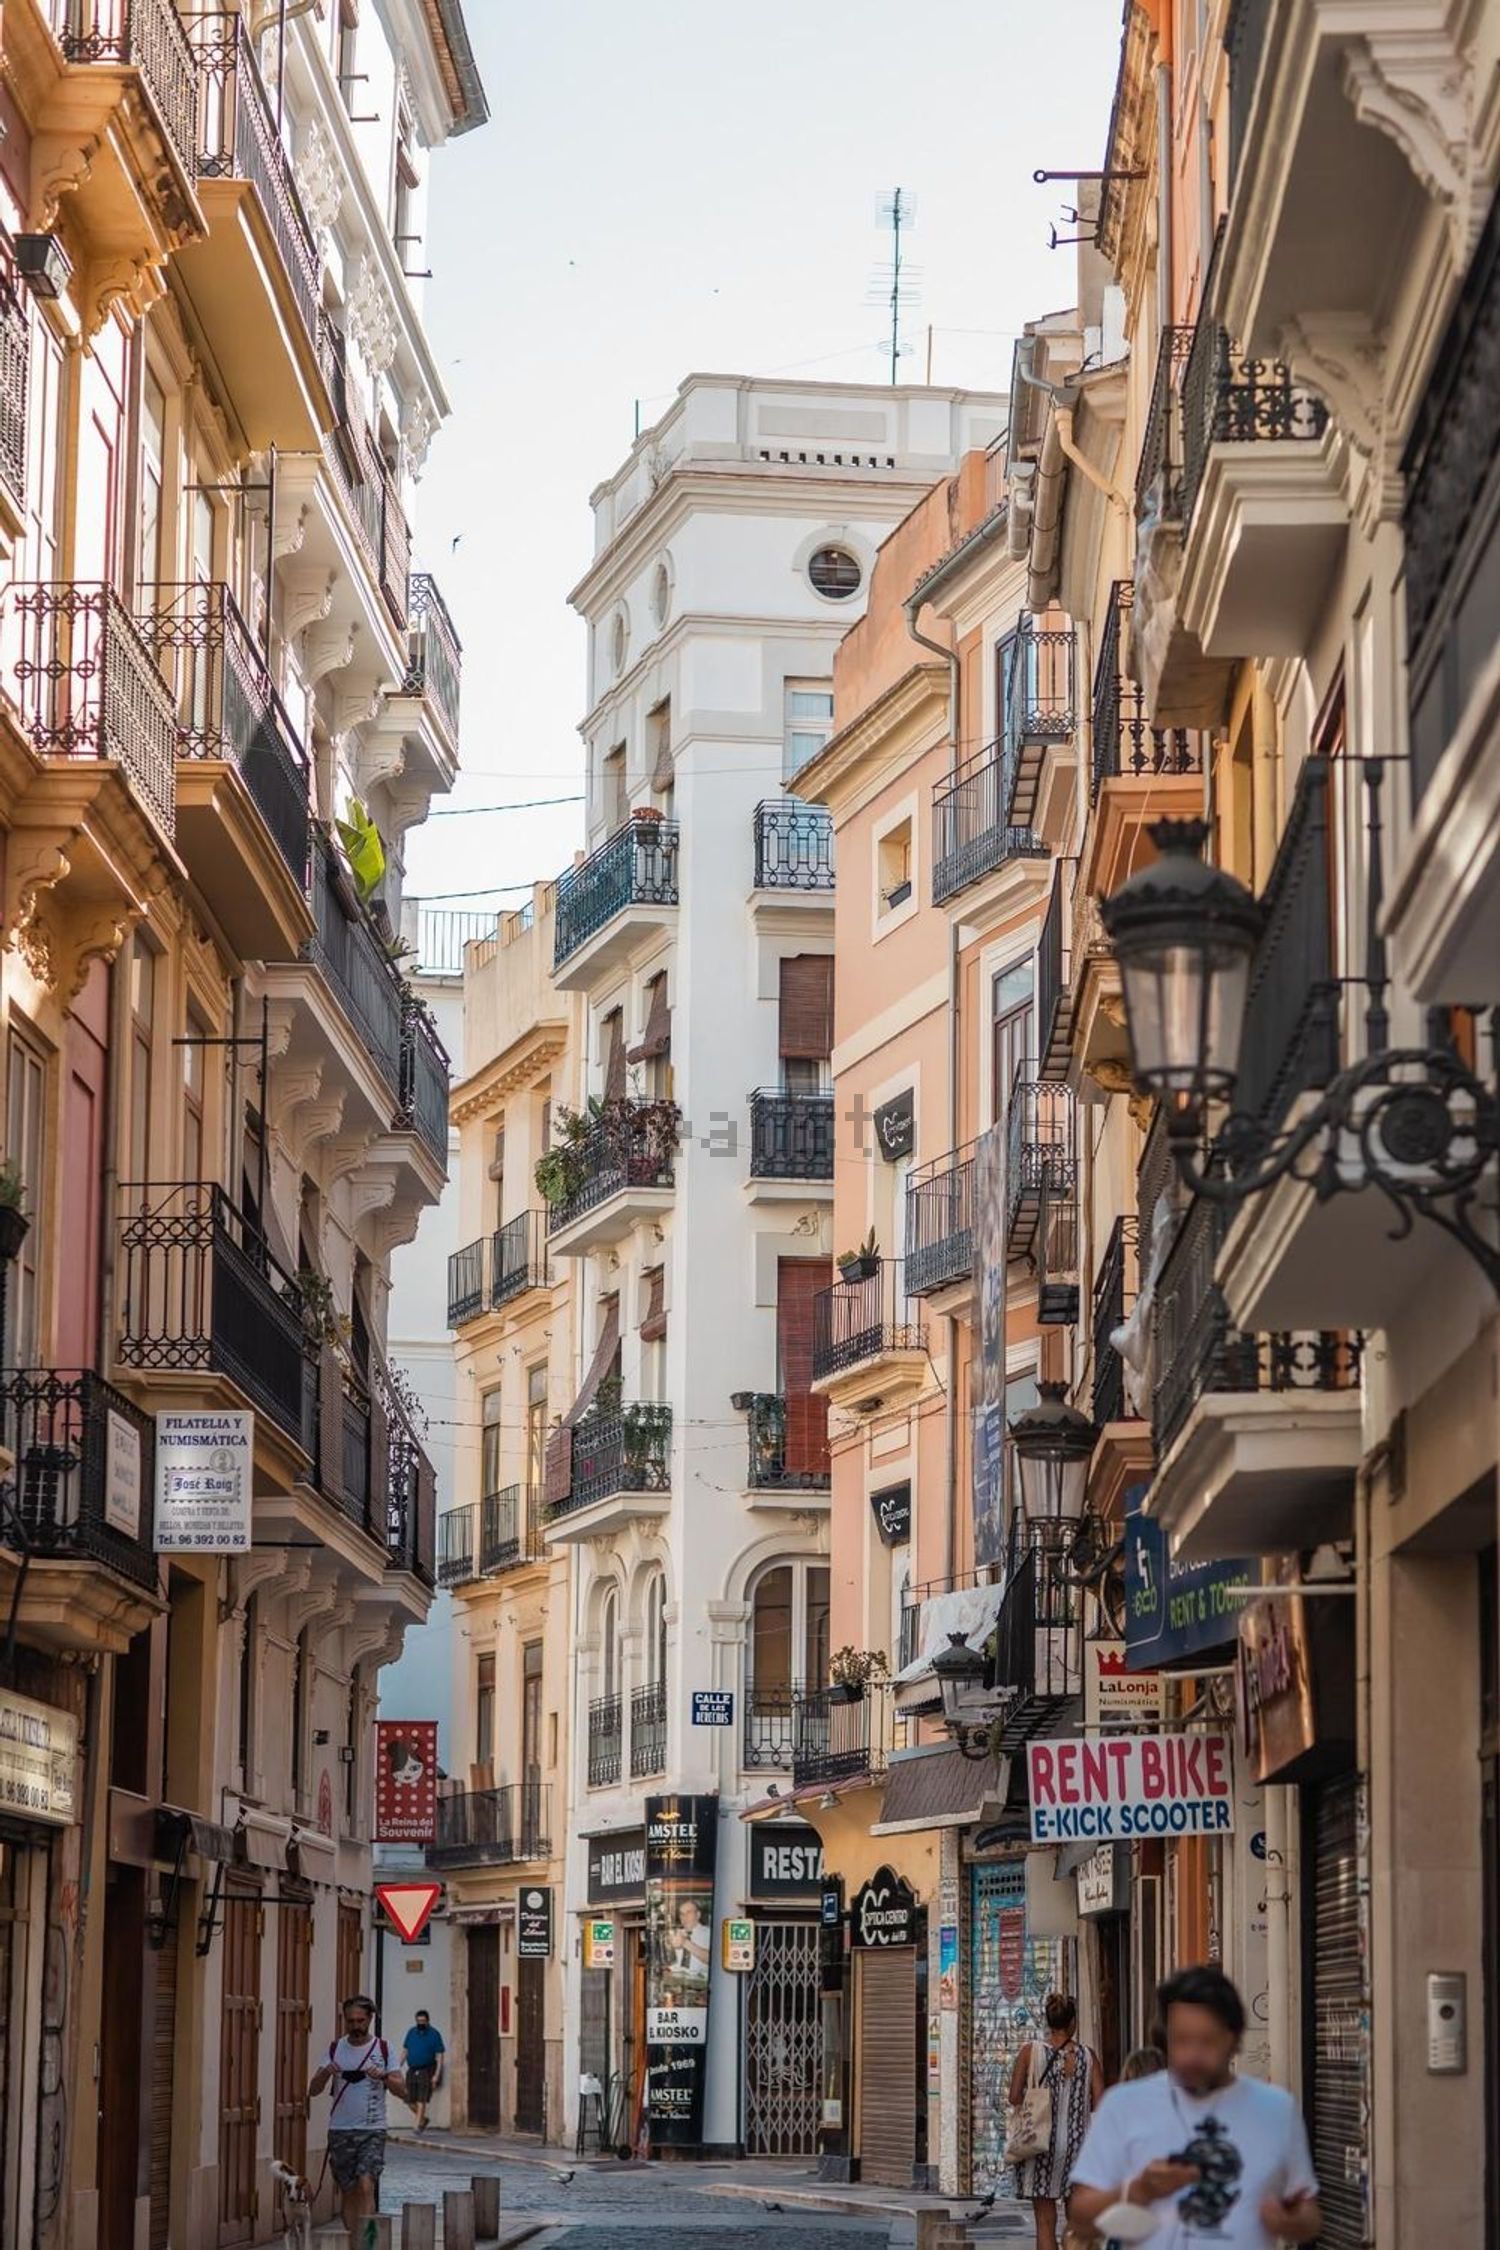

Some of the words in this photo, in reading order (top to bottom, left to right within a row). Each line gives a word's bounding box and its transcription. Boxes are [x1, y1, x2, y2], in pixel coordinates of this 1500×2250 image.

[166, 1418, 230, 1429] FILATELIA
[235, 1418, 242, 1429] Y
[160, 1431, 248, 1446] NUMISMÁTICA
[173, 1476, 201, 1492] José
[205, 1477, 233, 1492] Roig
[157, 1534, 175, 1545] Tel.
[178, 1534, 192, 1545] 96
[195, 1534, 214, 1545] 392
[216, 1534, 230, 1545] 00
[232, 1534, 246, 1545] 82
[1168, 1591, 1195, 1631] RENT
[1198, 1587, 1206, 1622] &
[1209, 1573, 1248, 1618] TOURS
[695, 1693, 731, 1705] CALLE
[695, 1711, 729, 1724] DERECHOS
[1032, 1742, 1132, 1806] RENT
[1141, 1737, 1229, 1799] BIKE
[379, 1818, 391, 1827] La
[392, 1817, 417, 1827] Reina
[419, 1817, 433, 1827] del
[1035, 1805, 1113, 1838] E-KICK
[1119, 1800, 1230, 1834] SCOOTER
[379, 1826, 433, 1838] Souvenir
[648, 1823, 697, 1838] AMSTEL
[657, 2011, 678, 2023] BAR
[657, 2026, 699, 2038] KIOSKO
[650, 2088, 692, 2102] AMSTEL
